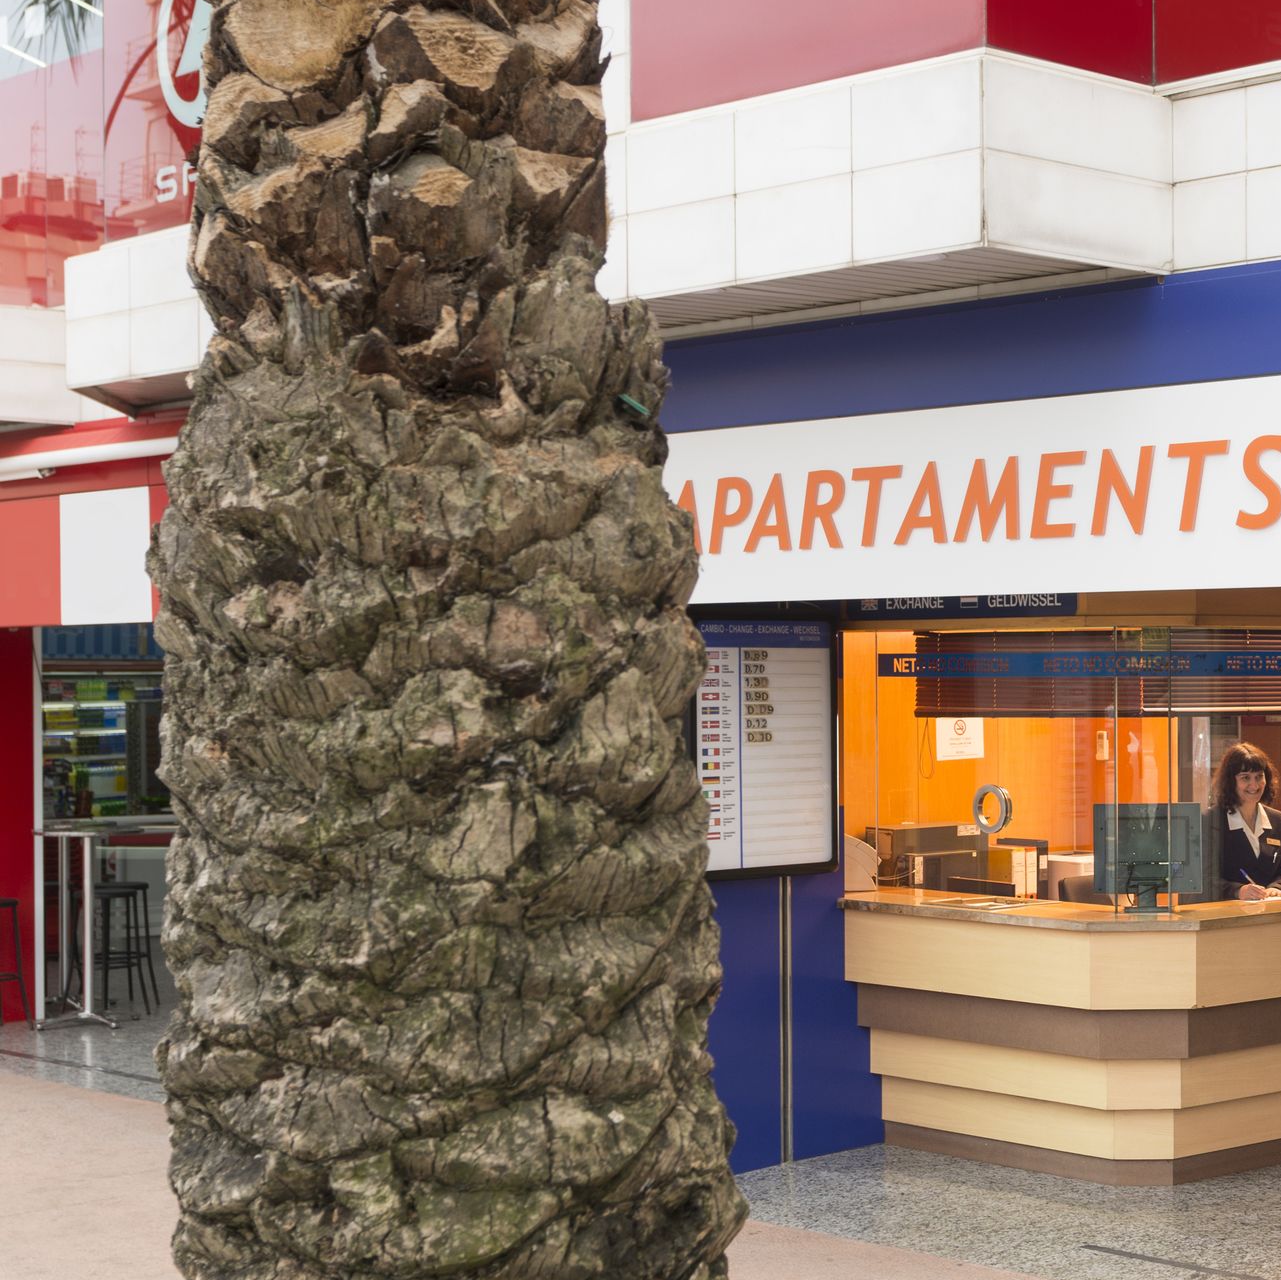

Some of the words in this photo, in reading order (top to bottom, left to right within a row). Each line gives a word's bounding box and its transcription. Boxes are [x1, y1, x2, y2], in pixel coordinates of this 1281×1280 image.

[886, 595, 944, 610] EXCHANGE
[987, 593, 1062, 608] GELDWISSEL
[700, 624, 724, 633] CAMBIO
[729, 624, 753, 634] CHANGE
[758, 625, 789, 634] EXCHANGE
[1227, 655, 1262, 671] NETO
